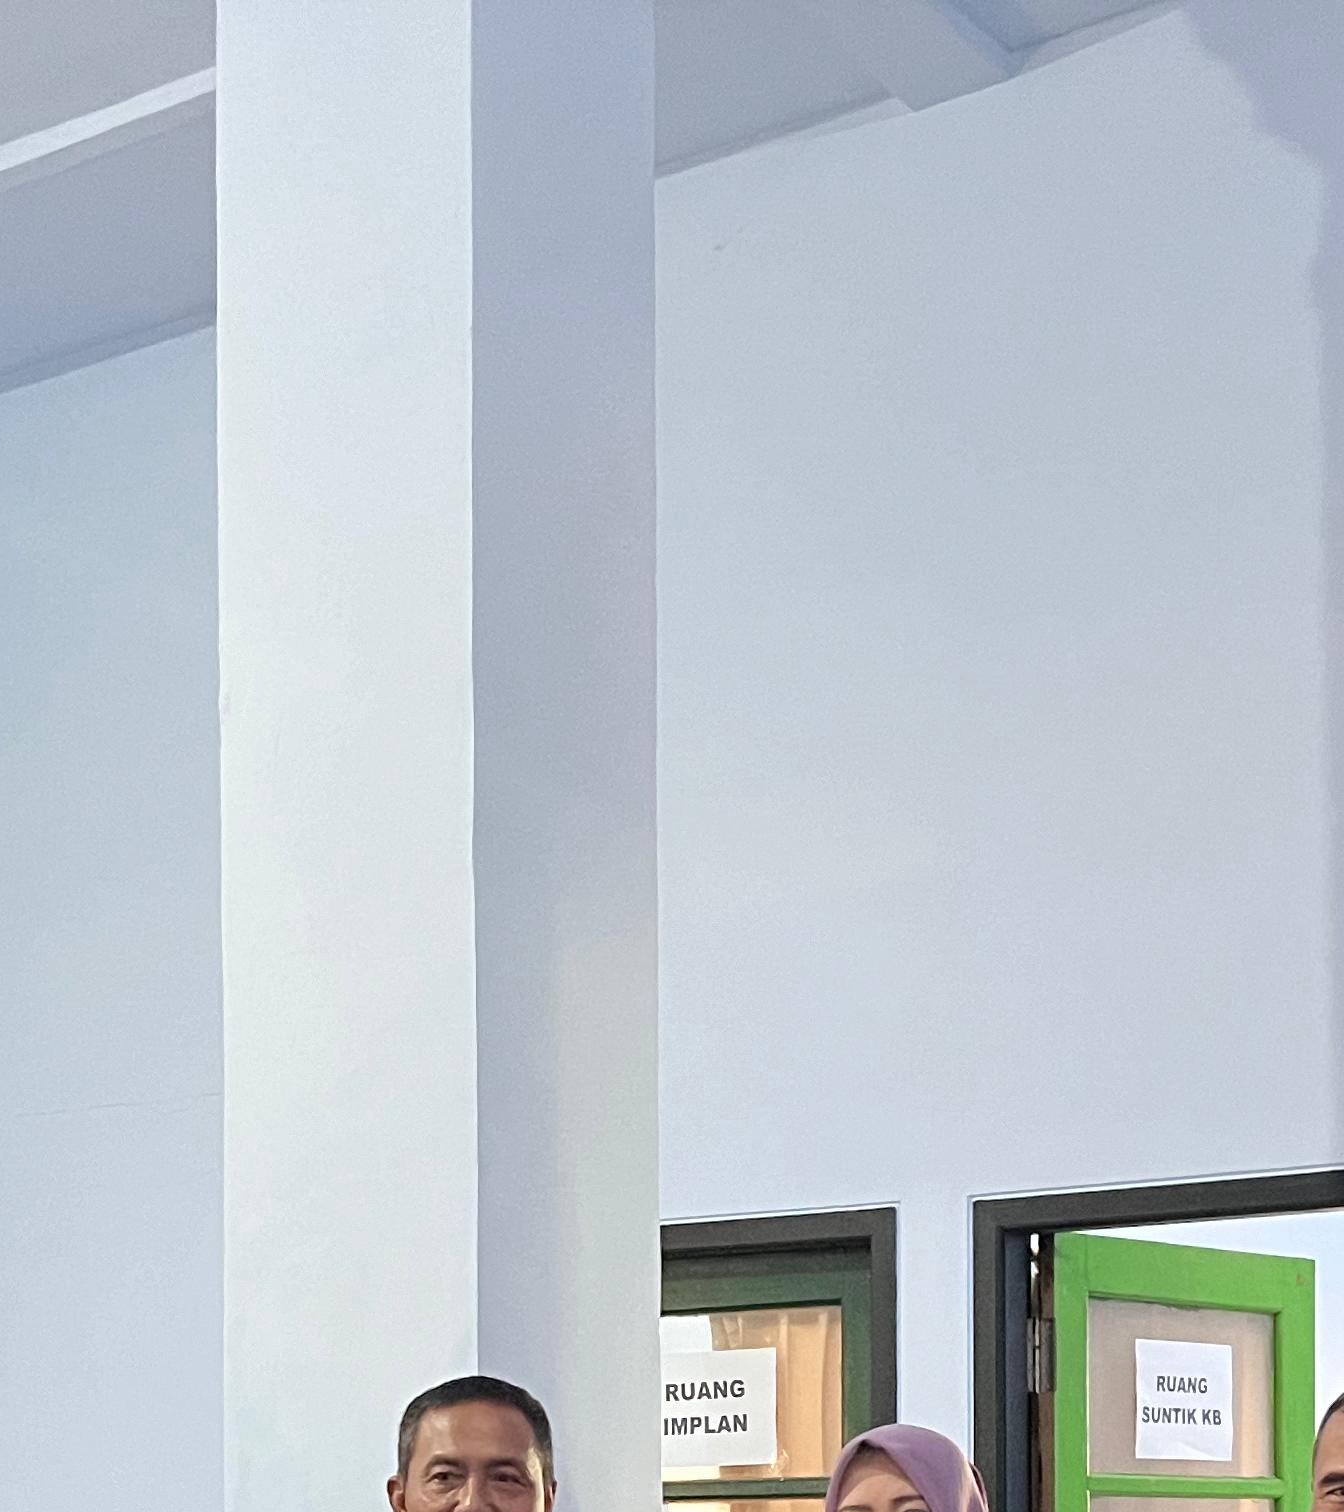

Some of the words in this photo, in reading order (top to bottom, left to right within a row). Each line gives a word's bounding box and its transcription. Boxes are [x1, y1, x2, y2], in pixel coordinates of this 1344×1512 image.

[665, 1379, 745, 1401] RUANG
[1157, 1375, 1207, 1394] RUANG
[663, 1413, 747, 1436] IMPLAN
[1141, 1406, 1197, 1425] SUNTIK
[1202, 1408, 1222, 1425] KB
